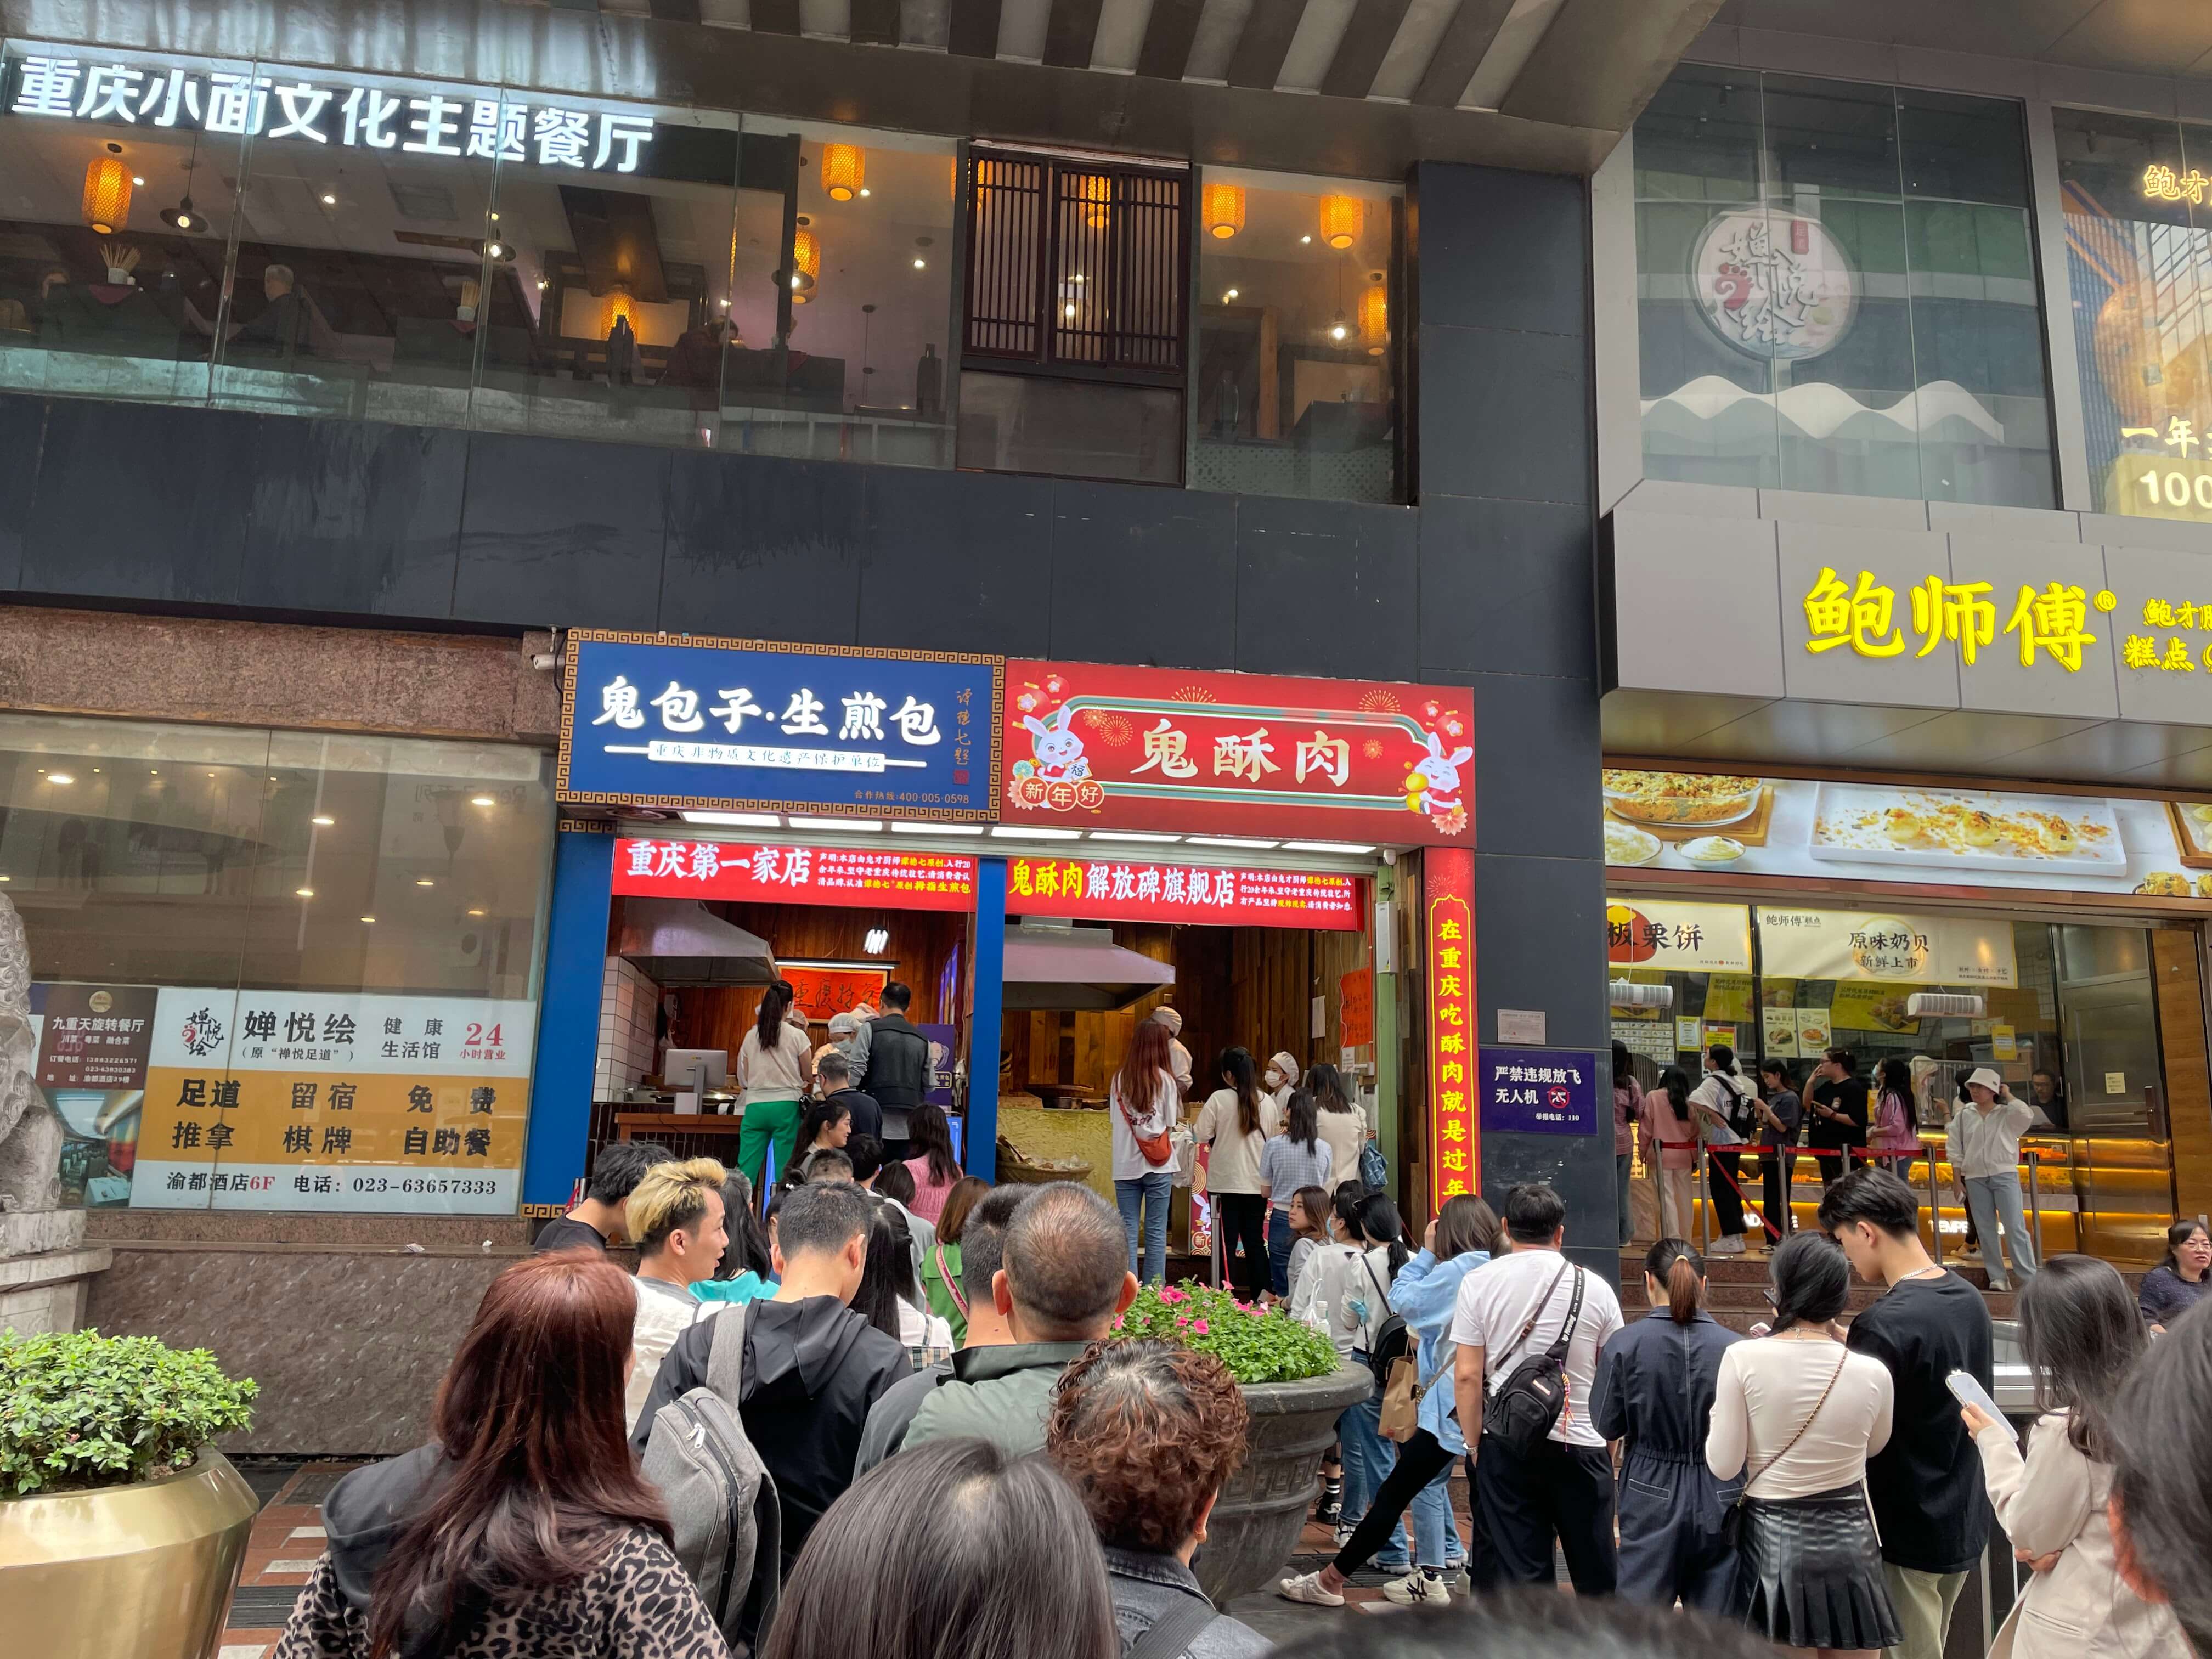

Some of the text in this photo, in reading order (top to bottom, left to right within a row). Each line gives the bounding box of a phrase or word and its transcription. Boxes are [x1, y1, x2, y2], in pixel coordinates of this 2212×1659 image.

[12, 56, 653, 173] 重庆小面文化主题餐厅
[2143, 165, 2211, 204] 鲍才
[2121, 416, 2211, 460] 一年
[2124, 634, 2194, 672] 糕点
[1130, 718, 1350, 787] 鬼酥肉
[1025, 782, 1099, 806] 新年好
[627, 840, 812, 887] 重庆第一家店
[1008, 860, 1235, 909] 鬼酥肉解放碑旗舰店
[1607, 922, 1704, 951] 板栗饼
[1848, 932, 1929, 952] 原味奶贝
[1860, 955, 1918, 969] 新鲜上市
[52, 1016, 144, 1032] 九重天旋转餐厅
[243, 1010, 357, 1045] 婵悦绘
[465, 1023, 503, 1046] 24
[381, 1041, 441, 1059] 生活馆
[460, 1049, 505, 1060] 小时营业
[1438, 919, 1469, 1195] 在重庆吃酥肉就是过年
[1494, 1066, 1582, 1085] 严禁违规放飞
[176, 1079, 496, 1115] 足道 留宿 免费
[1495, 1088, 1539, 1104] 无人机
[172, 1121, 490, 1158] 推拿 棋牌 自助餐
[166, 1171, 275, 1192] 渝都酒店6F
